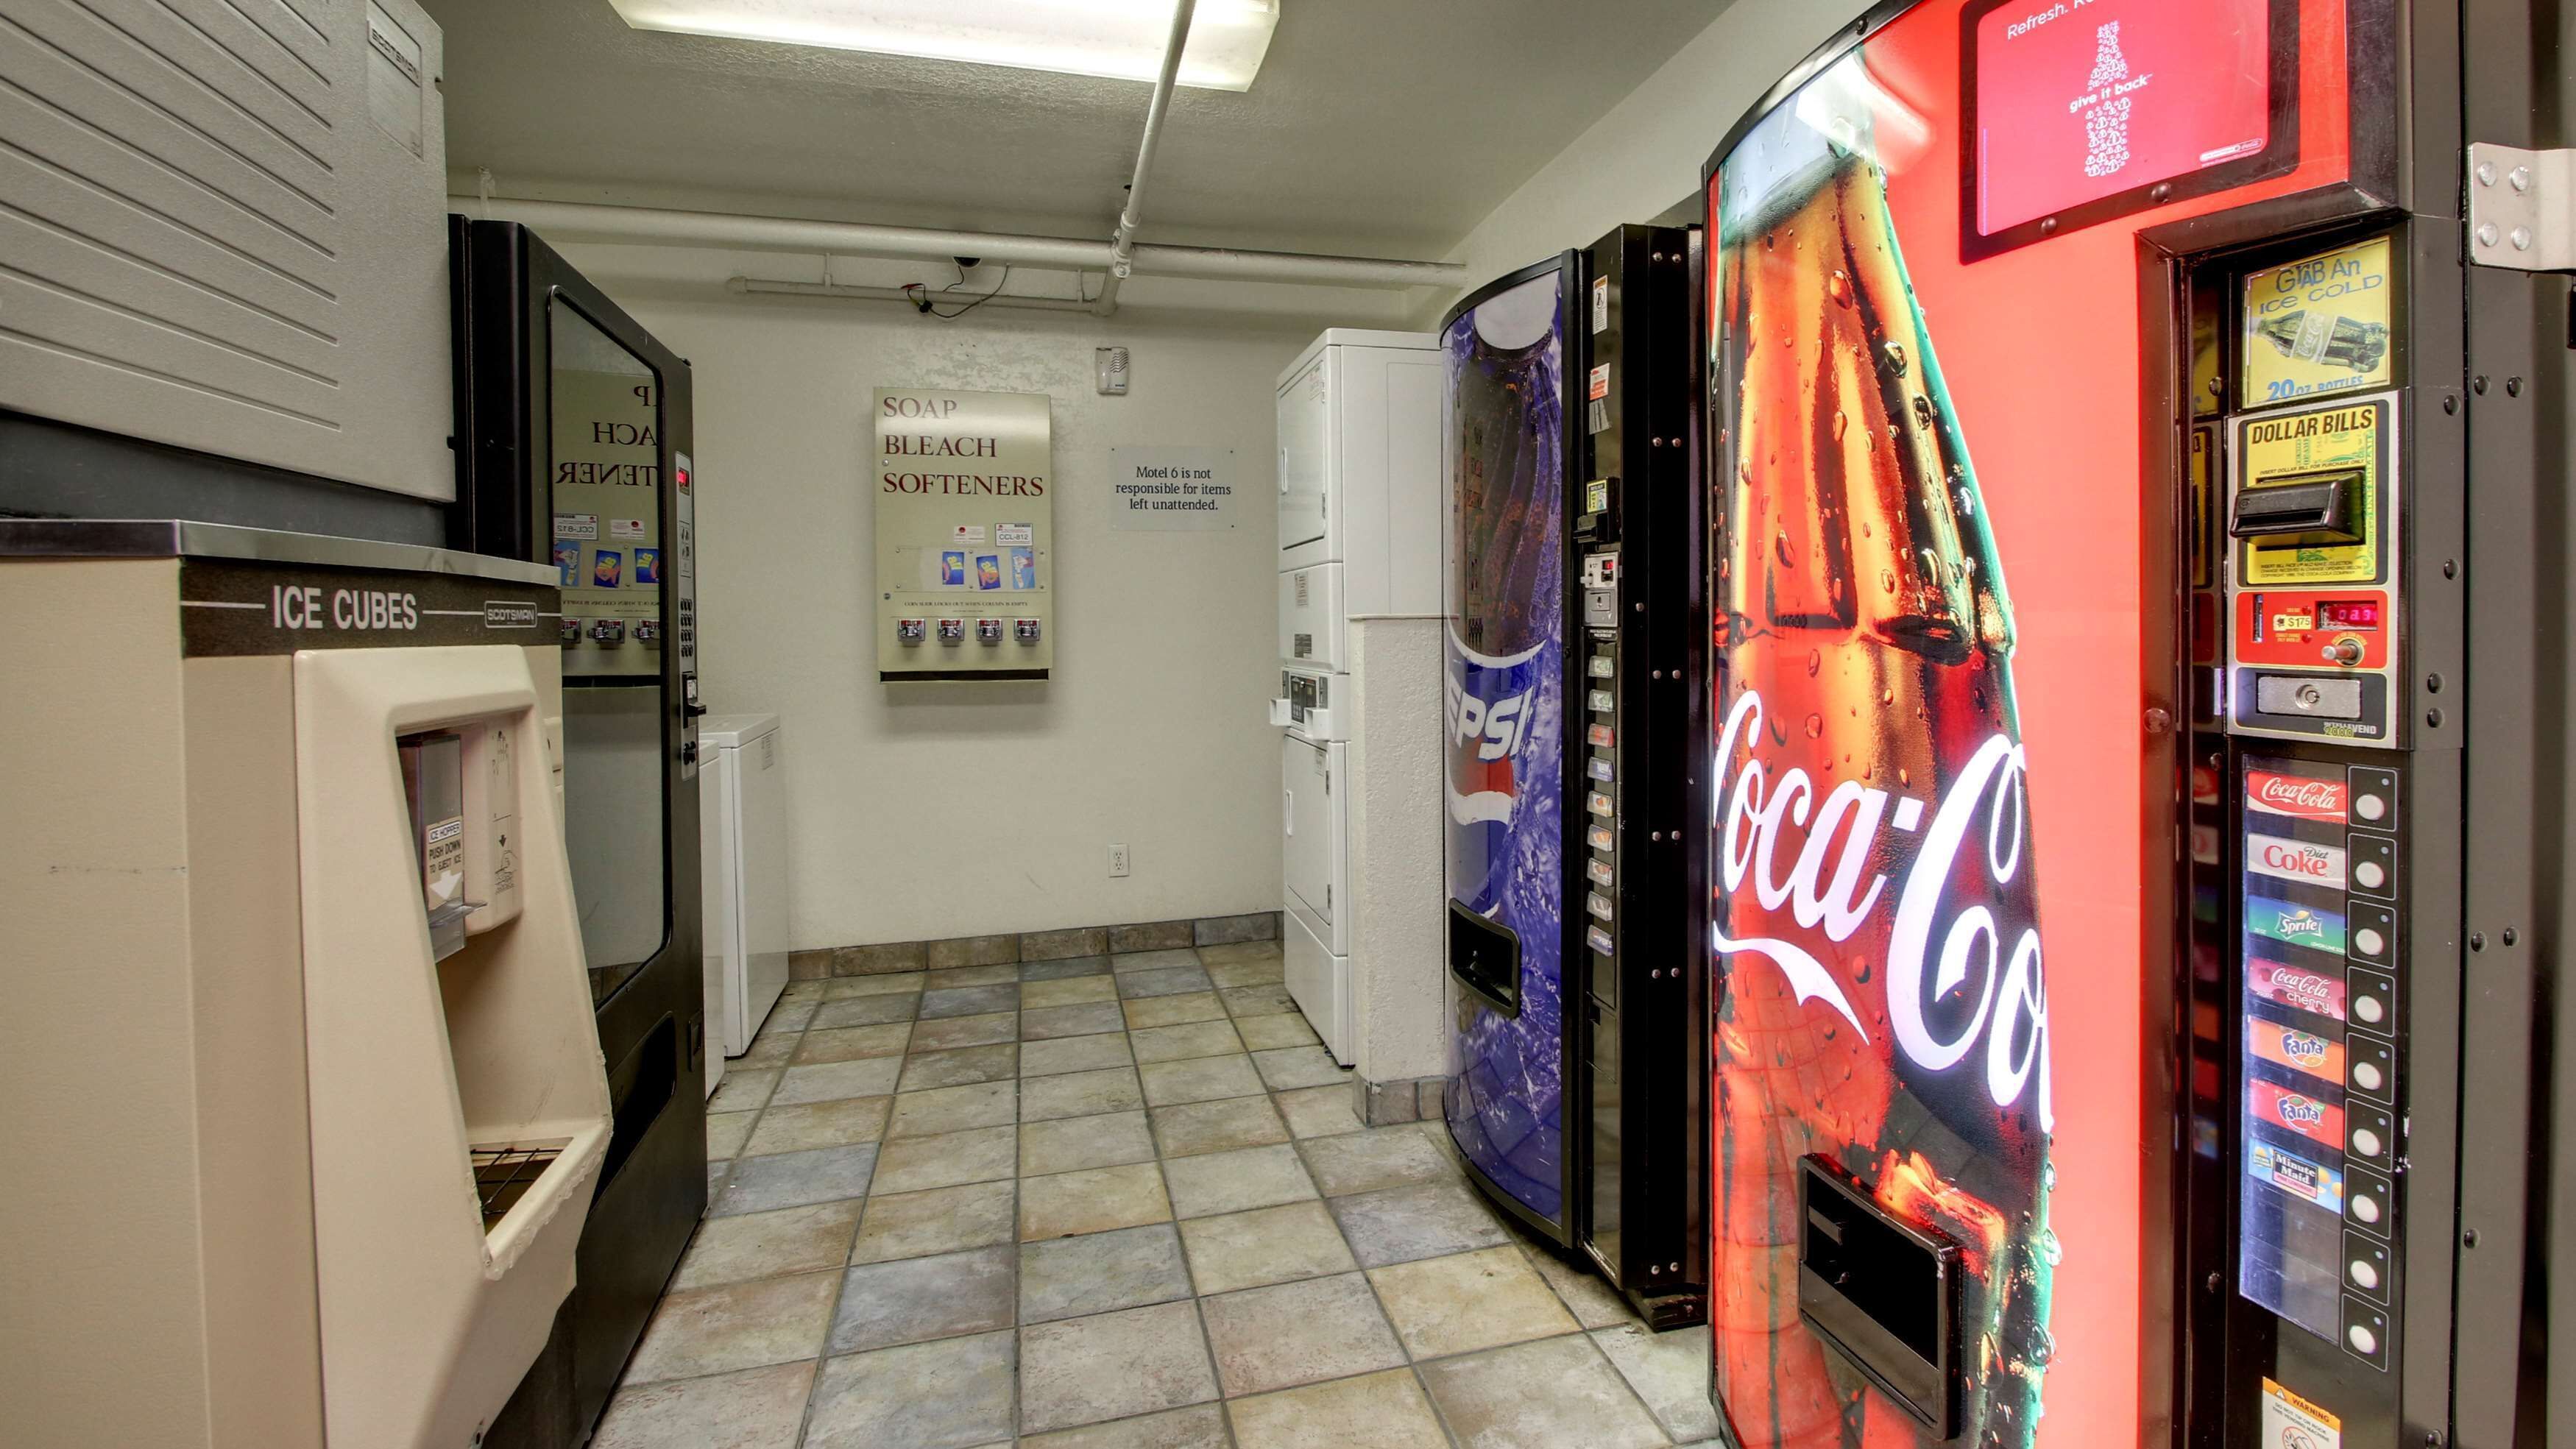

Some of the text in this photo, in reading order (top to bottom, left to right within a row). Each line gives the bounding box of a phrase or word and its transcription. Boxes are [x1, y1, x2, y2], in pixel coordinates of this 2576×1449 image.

[2008, 3, 2068, 40] Refresh.
[2070, 74, 2148, 113] give it back
[2331, 258, 2360, 280] An
[2308, 274, 2382, 302] COLD
[2268, 379, 2295, 401] 20
[883, 397, 957, 419] SOAP
[2252, 409, 2372, 444] DOLLAR BILLS
[884, 434, 997, 458] BLEACH
[1136, 466, 1211, 479] Motel 6 is not
[883, 472, 1043, 497] SOFTENERS
[1116, 483, 1231, 496] responsible for items
[1130, 498, 1218, 510] left unattended.
[273, 585, 417, 630] ICE CUBES
[487, 609, 535, 621] SCOTSMAN
[1448, 670, 1534, 760] EPSI
[2261, 776, 2341, 809] Coca-Cola
[429, 839, 461, 860] PUSH DOWN
[2264, 845, 2328, 876] Coke
[2304, 846, 2329, 860] Diet
[2280, 919, 2318, 935] Sprite
[2271, 968, 2332, 997] Coca-Cola
[2287, 991, 2329, 1013] cherry
[2282, 1033, 2324, 1056] Fanta
[2278, 1097, 2321, 1123] Fanta
[2276, 1154, 2316, 1177] Minute
[2281, 1166, 2310, 1184] Maid
[2292, 1397, 2329, 1423] WARNING
